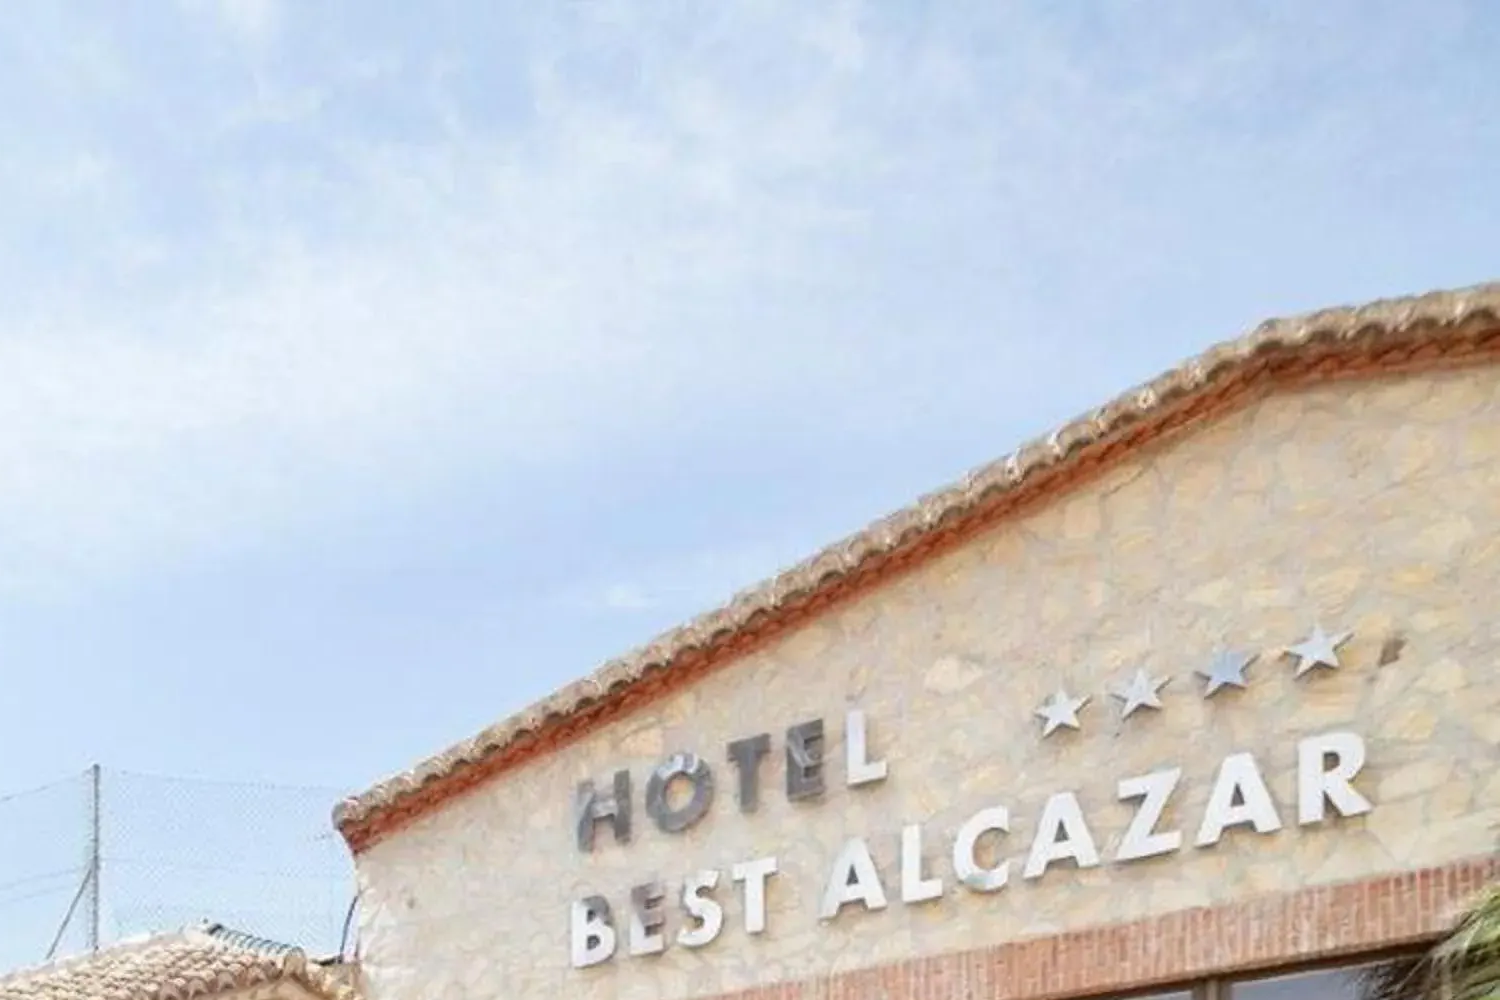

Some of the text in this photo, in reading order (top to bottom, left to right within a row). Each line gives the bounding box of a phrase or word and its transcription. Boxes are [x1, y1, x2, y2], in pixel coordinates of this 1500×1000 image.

[571, 731, 1373, 969] BEST ALCAZAR
[577, 711, 888, 851] HOTEL
